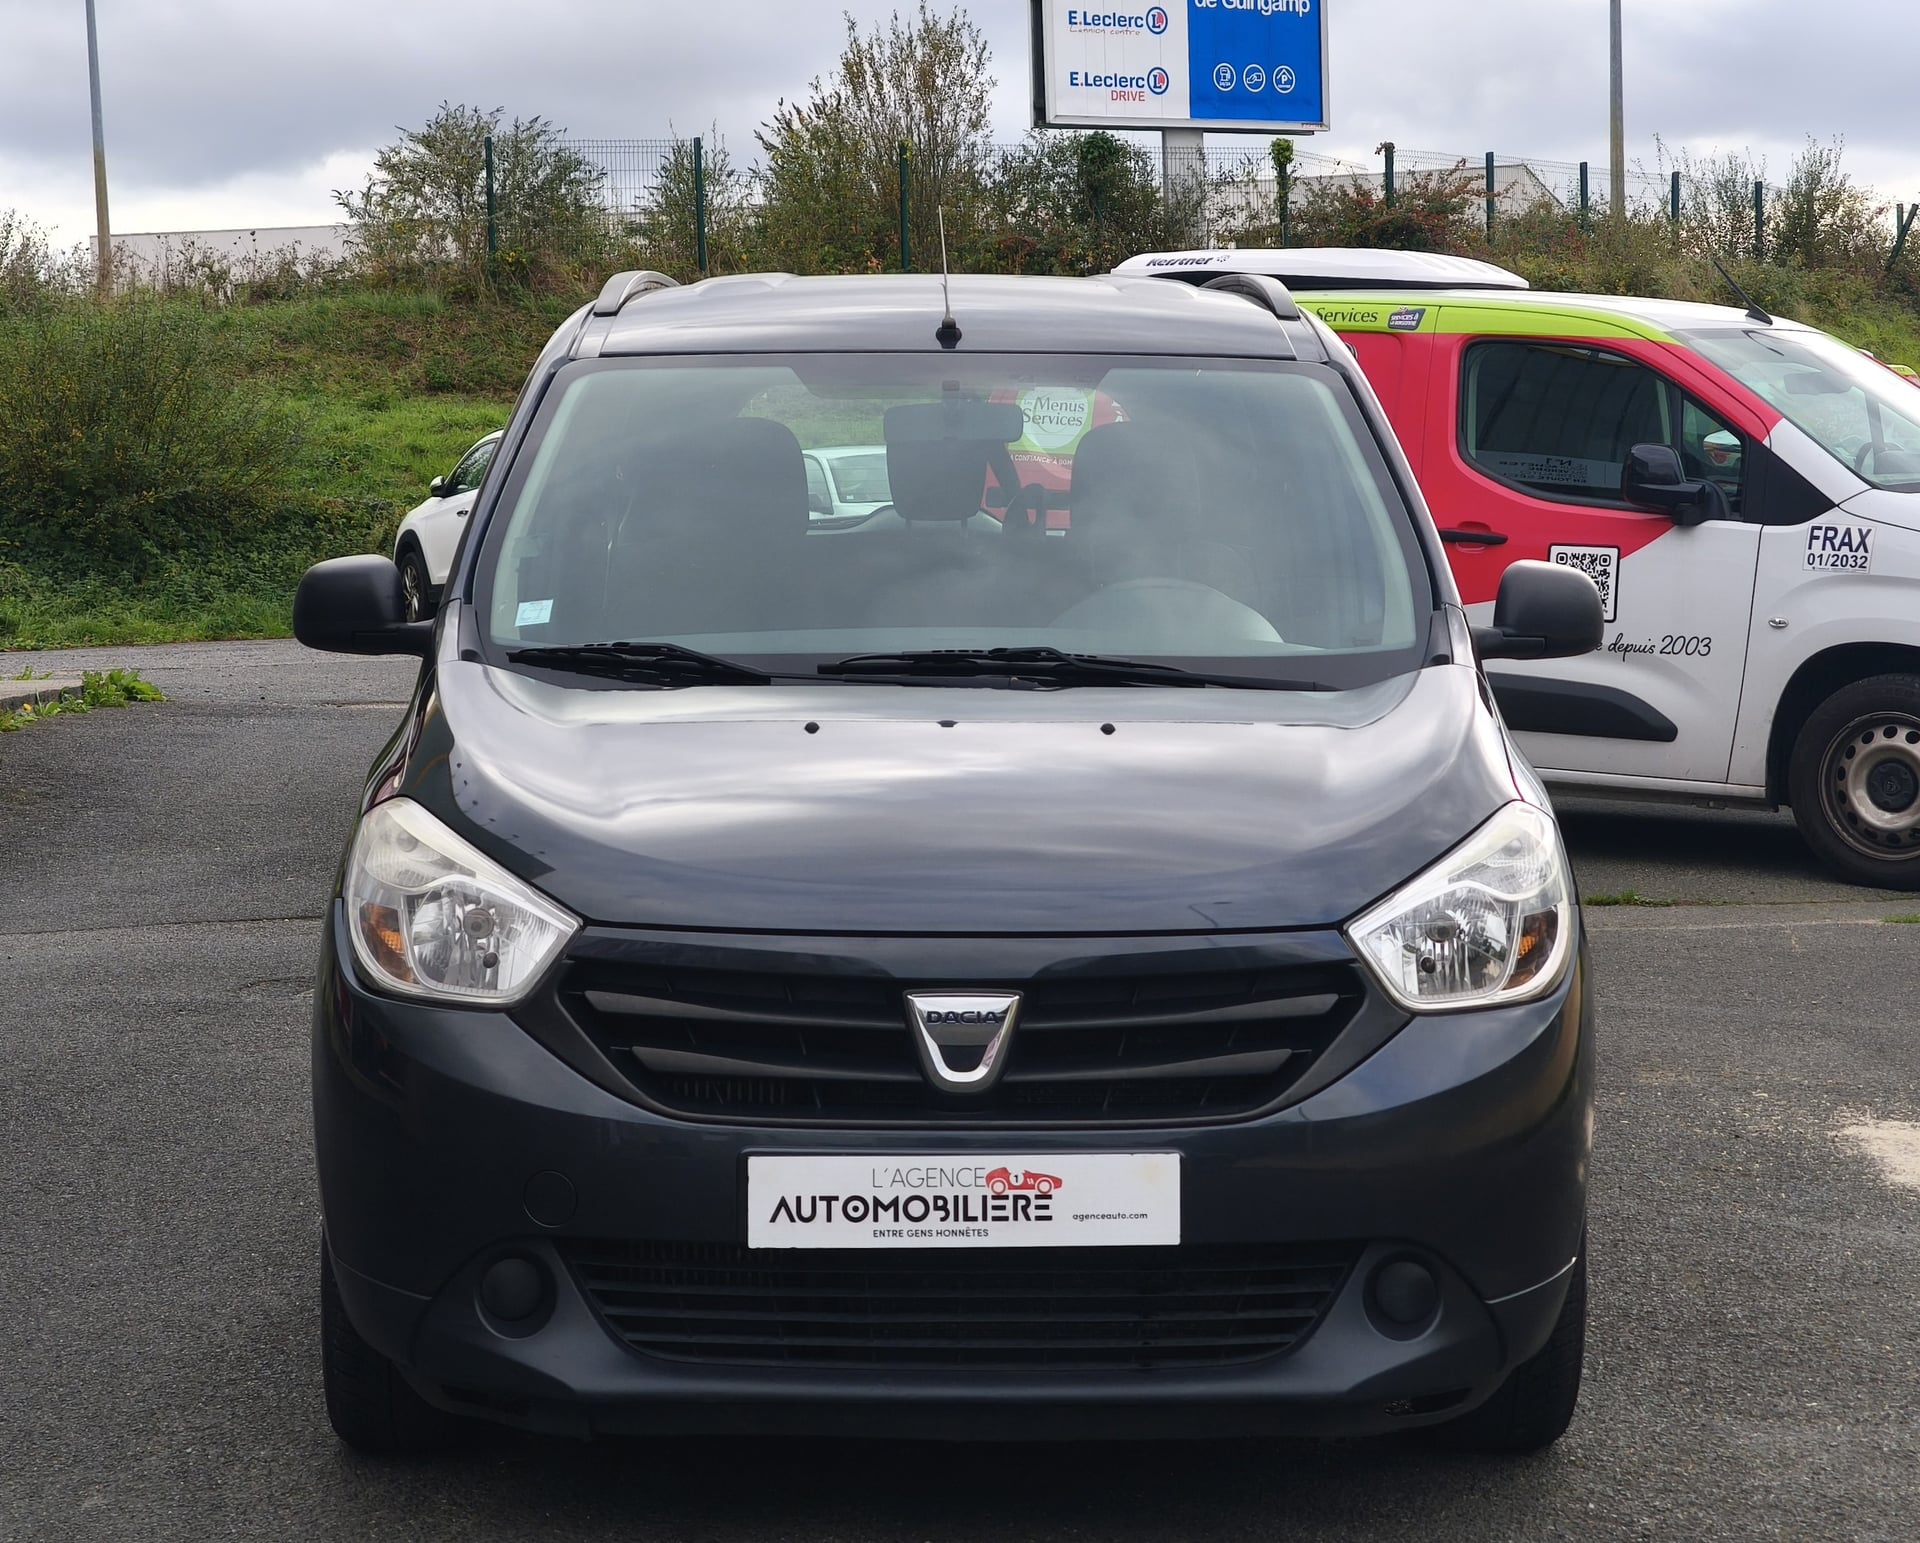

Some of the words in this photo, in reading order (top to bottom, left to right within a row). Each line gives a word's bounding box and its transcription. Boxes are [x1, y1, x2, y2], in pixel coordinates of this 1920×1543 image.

[1068, 10, 1144, 28] E.Leclerc
[1069, 71, 1145, 89] E.Leclerc
[1111, 90, 1146, 102] DRIVE
[1315, 307, 1379, 323] Services
[1034, 396, 1085, 413] Menus
[1022, 407, 1083, 427] Services
[1807, 526, 1872, 554] FRAX
[1807, 553, 1868, 569] 01/2032
[1608, 632, 1655, 662] depuis
[1659, 635, 1712, 656] 2003
[926, 1010, 1001, 1025] DACIA
[872, 1167, 986, 1189] L'AGENCE
[1072, 1211, 1149, 1222] agenceauto.com
[872, 1229, 905, 1239] ENTRE
[906, 1228, 933, 1239] GENS
[935, 1225, 990, 1238] HONNÊTES
